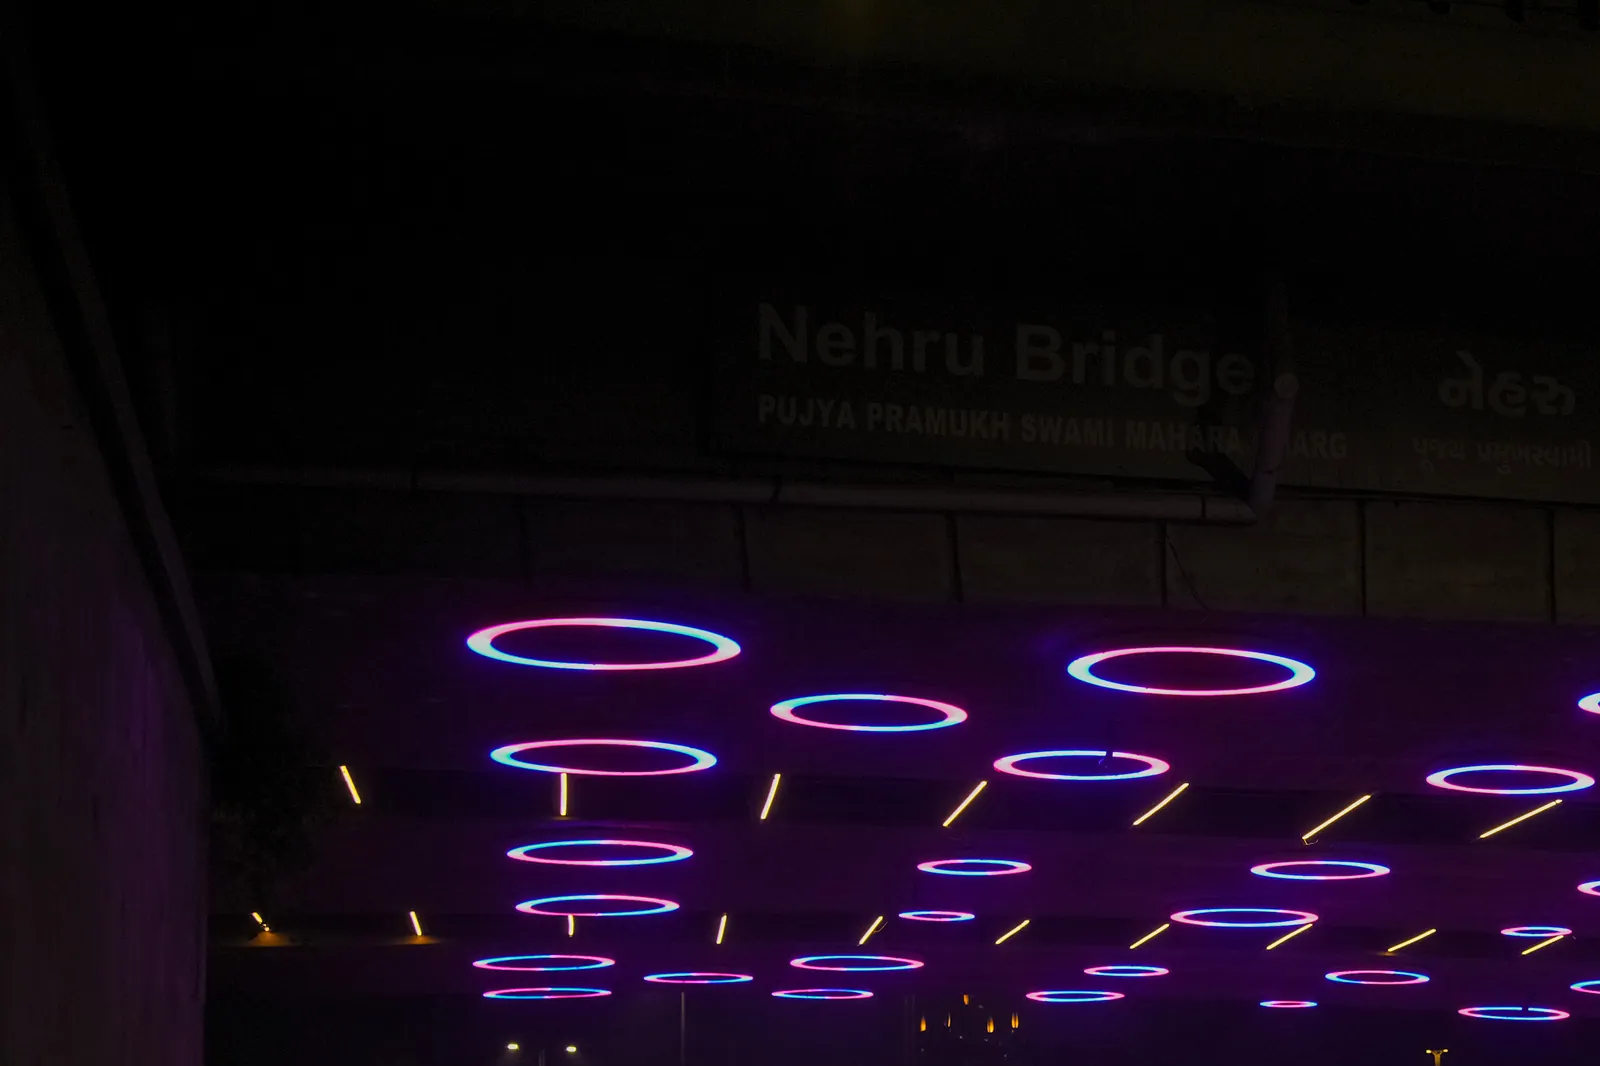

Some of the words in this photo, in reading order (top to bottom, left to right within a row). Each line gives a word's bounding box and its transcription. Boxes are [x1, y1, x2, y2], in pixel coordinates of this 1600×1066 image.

[758, 302, 985, 377] Nehru
[1015, 322, 1256, 407] Bridge
[757, 393, 857, 430] PUJYA
[867, 401, 1011, 441] PRAMUKH
[1021, 412, 1116, 448] SWAMI
[1125, 420, 1250, 455] MAHARA
